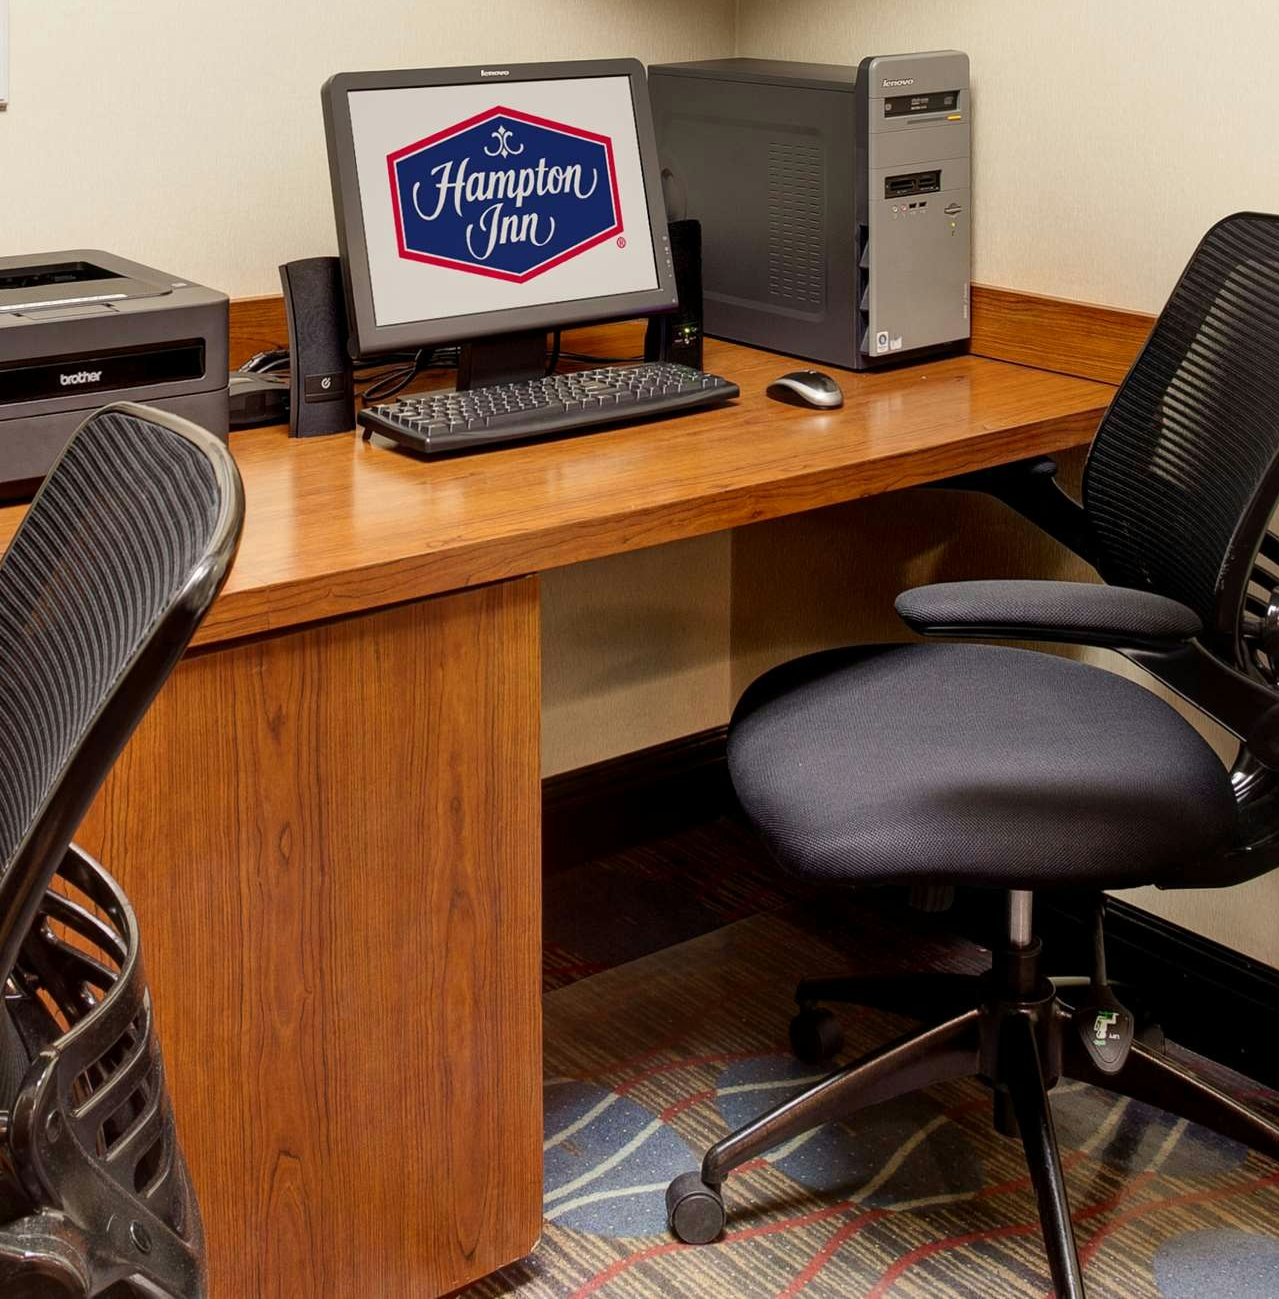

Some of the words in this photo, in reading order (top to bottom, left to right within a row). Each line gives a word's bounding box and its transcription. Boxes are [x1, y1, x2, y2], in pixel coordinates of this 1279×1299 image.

[883, 78, 914, 88] lenovo
[412, 157, 598, 221] Hampton
[466, 202, 555, 260] Inn
[60, 371, 102, 385] brother
